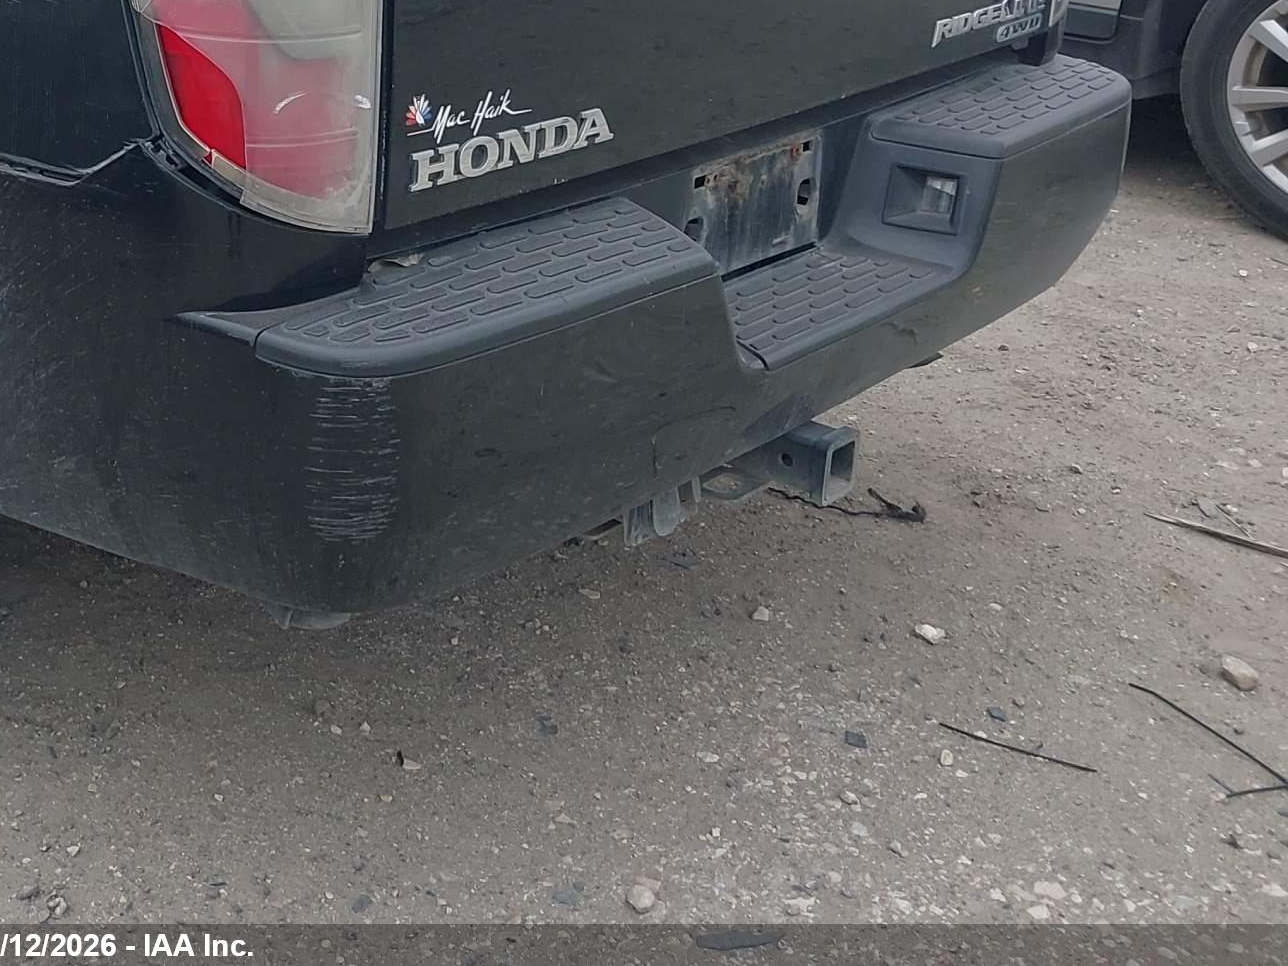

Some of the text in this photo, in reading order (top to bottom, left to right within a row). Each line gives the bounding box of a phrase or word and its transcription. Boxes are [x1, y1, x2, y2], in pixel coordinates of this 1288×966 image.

[999, 14, 1042, 40] 4WD
[406, 88, 533, 144] Mac Haik
[408, 107, 614, 194] HONDA
